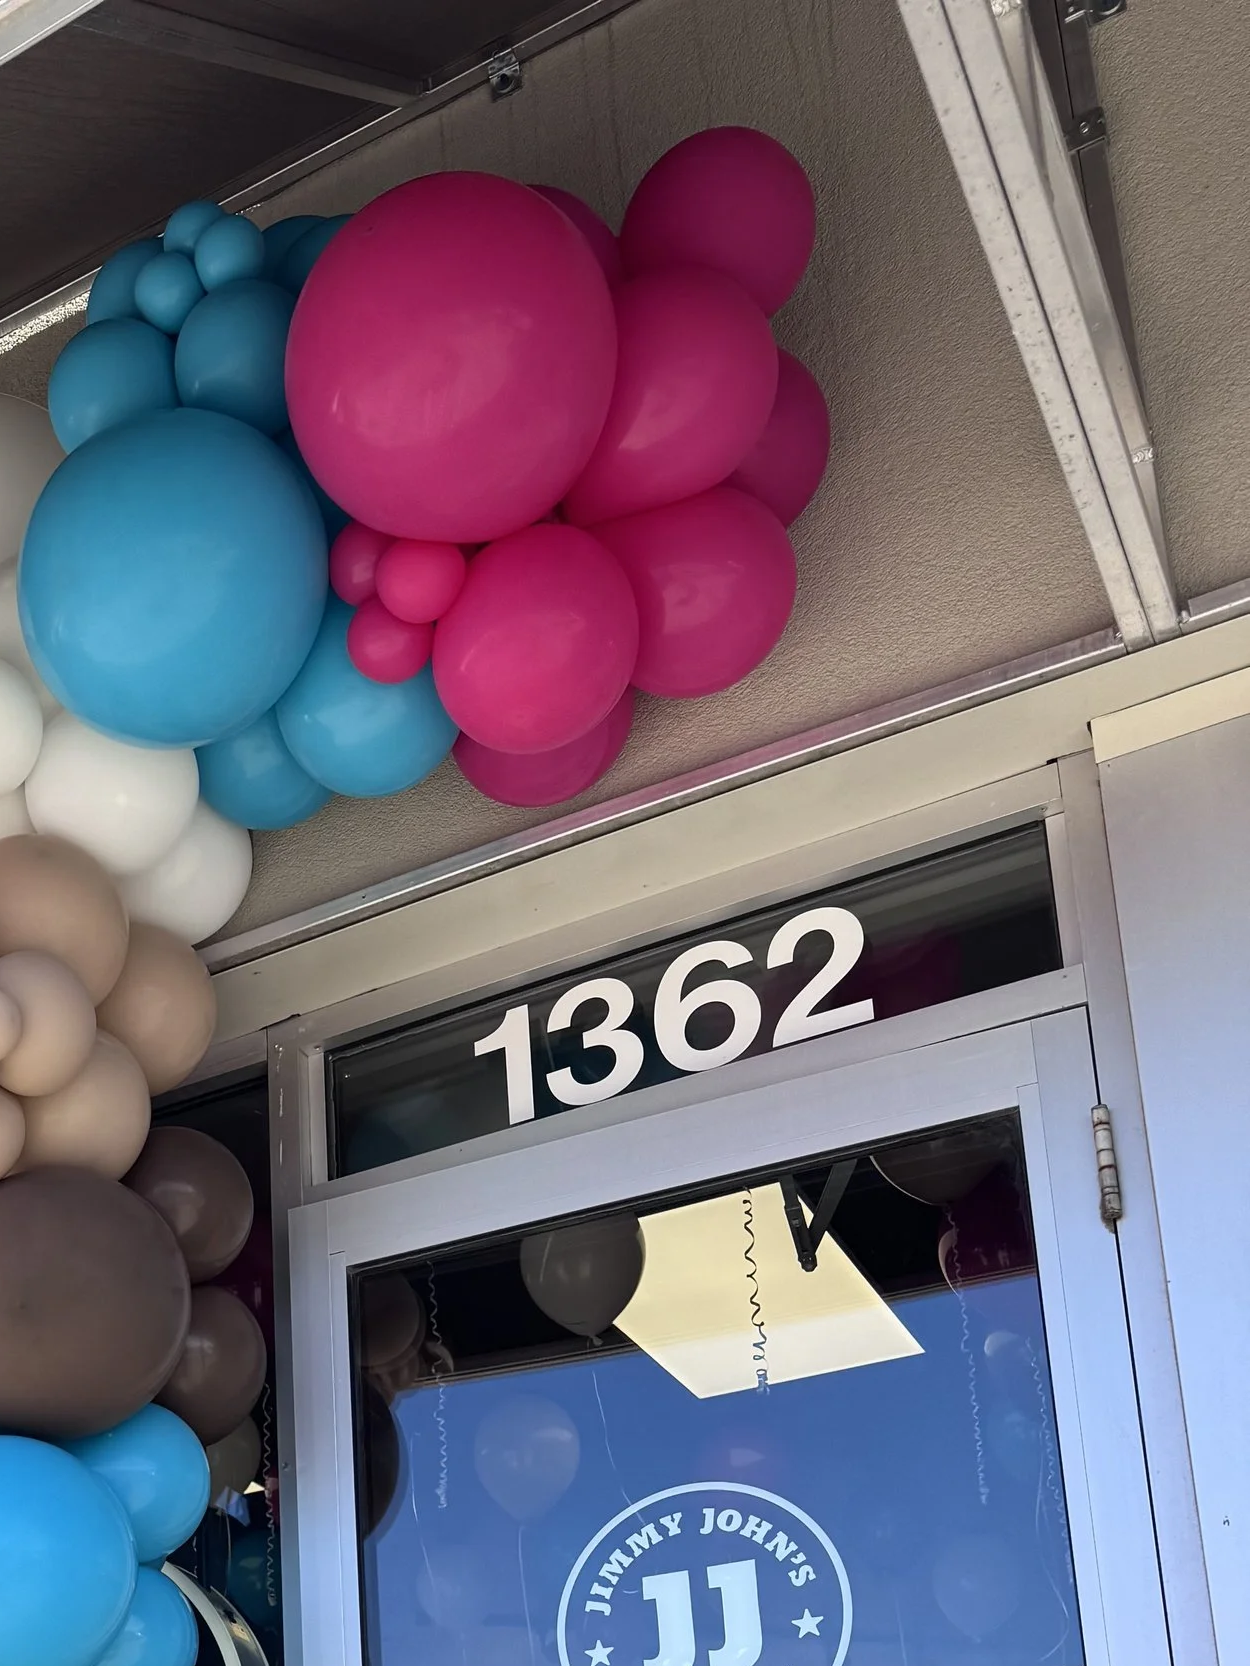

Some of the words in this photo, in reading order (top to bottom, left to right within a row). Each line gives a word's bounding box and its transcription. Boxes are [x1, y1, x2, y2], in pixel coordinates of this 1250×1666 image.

[474, 906, 874, 1125] 1362
[585, 1511, 684, 1616] JIMMY
[699, 1507, 817, 1588] JOHN'S
